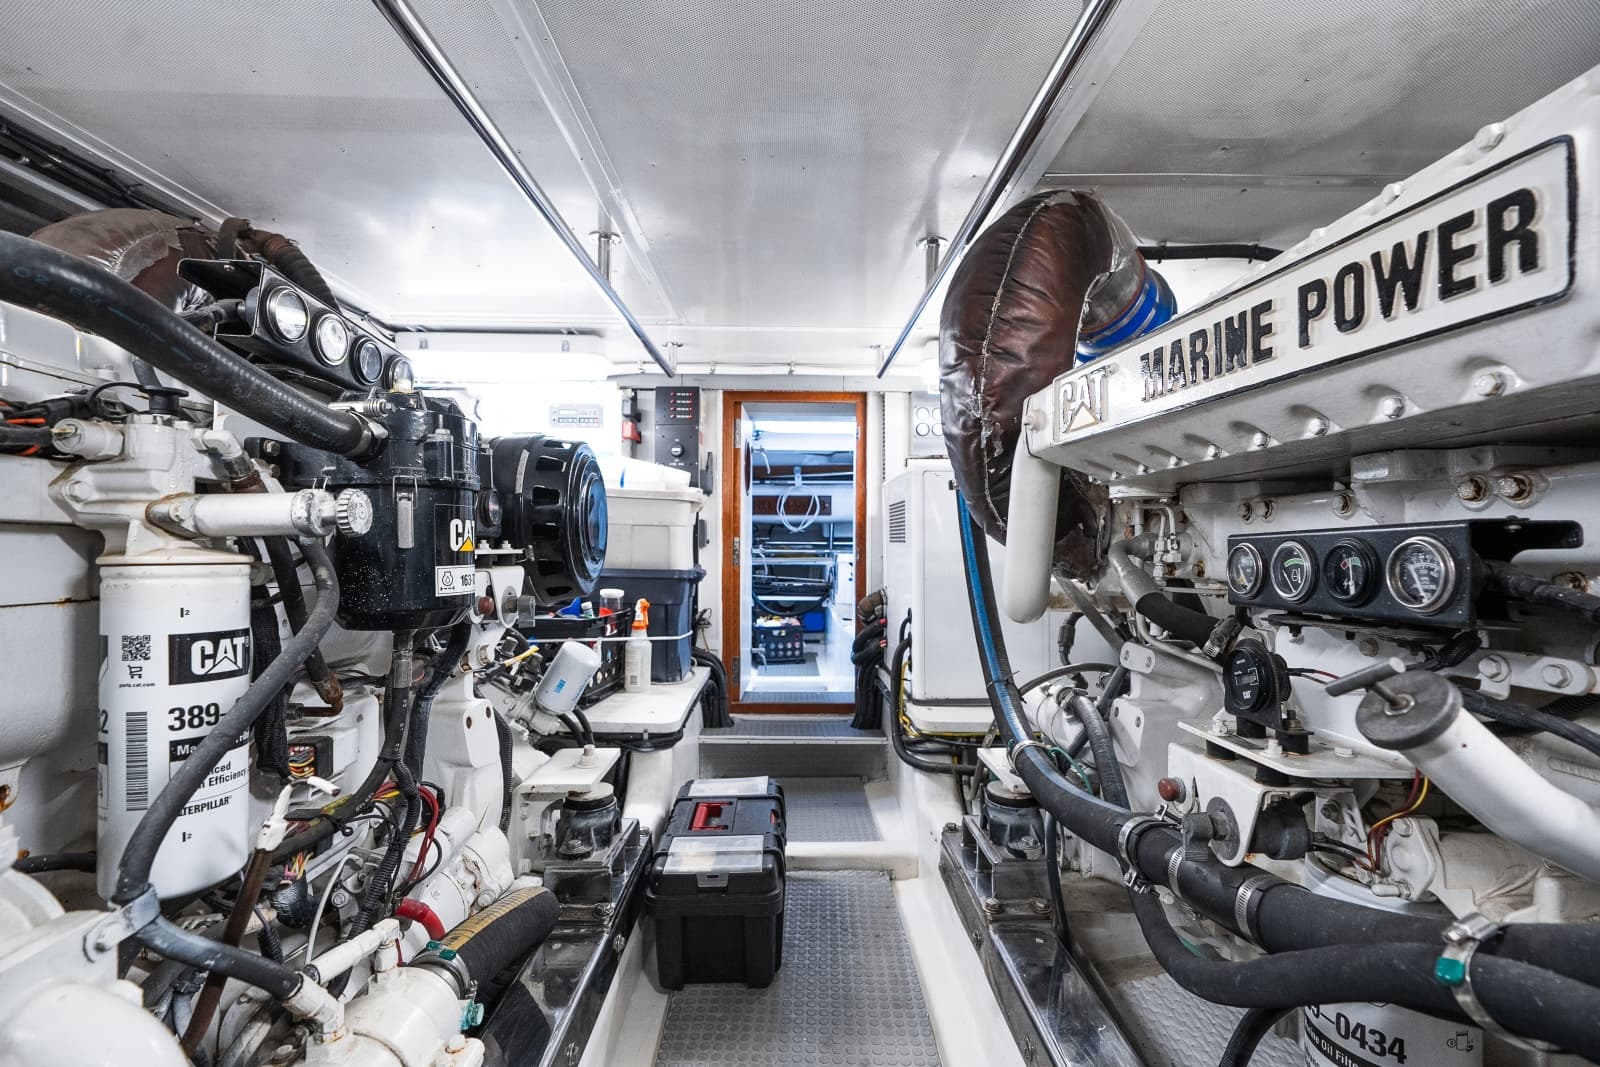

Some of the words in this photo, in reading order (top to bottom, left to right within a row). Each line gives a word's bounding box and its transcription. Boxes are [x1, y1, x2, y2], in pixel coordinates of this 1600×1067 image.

[1059, 367, 1112, 432] CAT
[1140, 299, 1276, 401] MARINE
[1298, 188, 1540, 348] POWER
[208, 767, 247, 787] Efficiency
[1321, 1039, 1333, 1056] Oil
